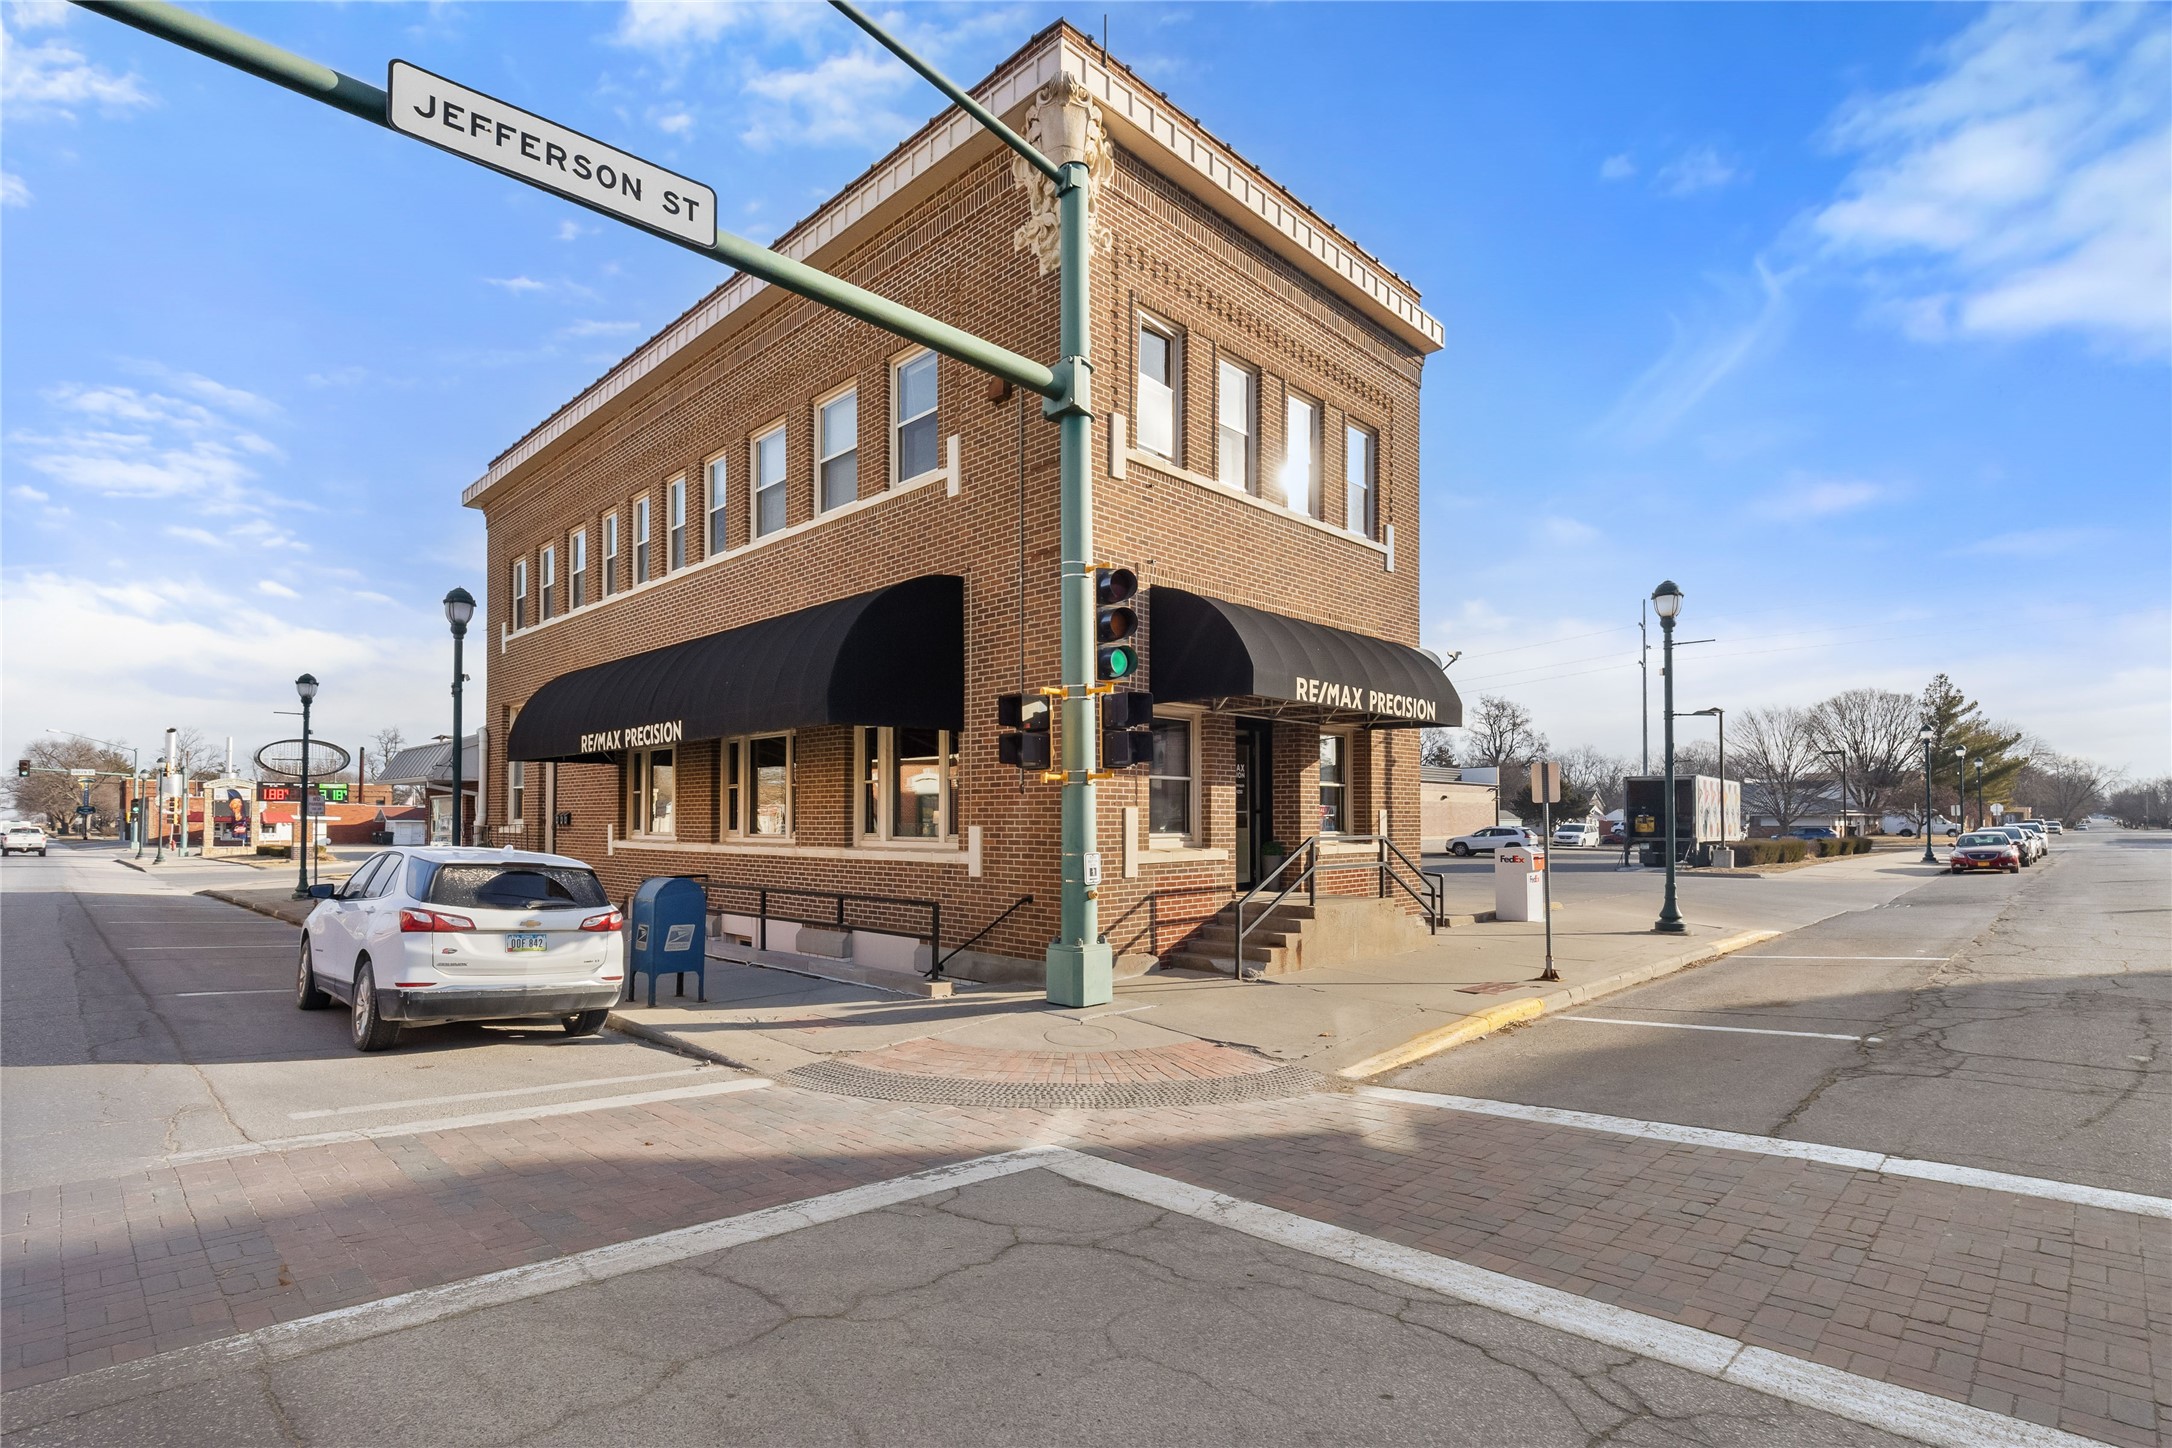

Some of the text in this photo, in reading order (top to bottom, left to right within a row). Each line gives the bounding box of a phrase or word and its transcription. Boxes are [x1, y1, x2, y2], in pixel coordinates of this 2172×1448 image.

[413, 95, 700, 222] JEFFERSON ST
[1296, 677, 1436, 721] RE/MAX PRECISION
[581, 720, 682, 753] RE/MAX PRECISION
[1500, 855, 1525, 864] FedEx
